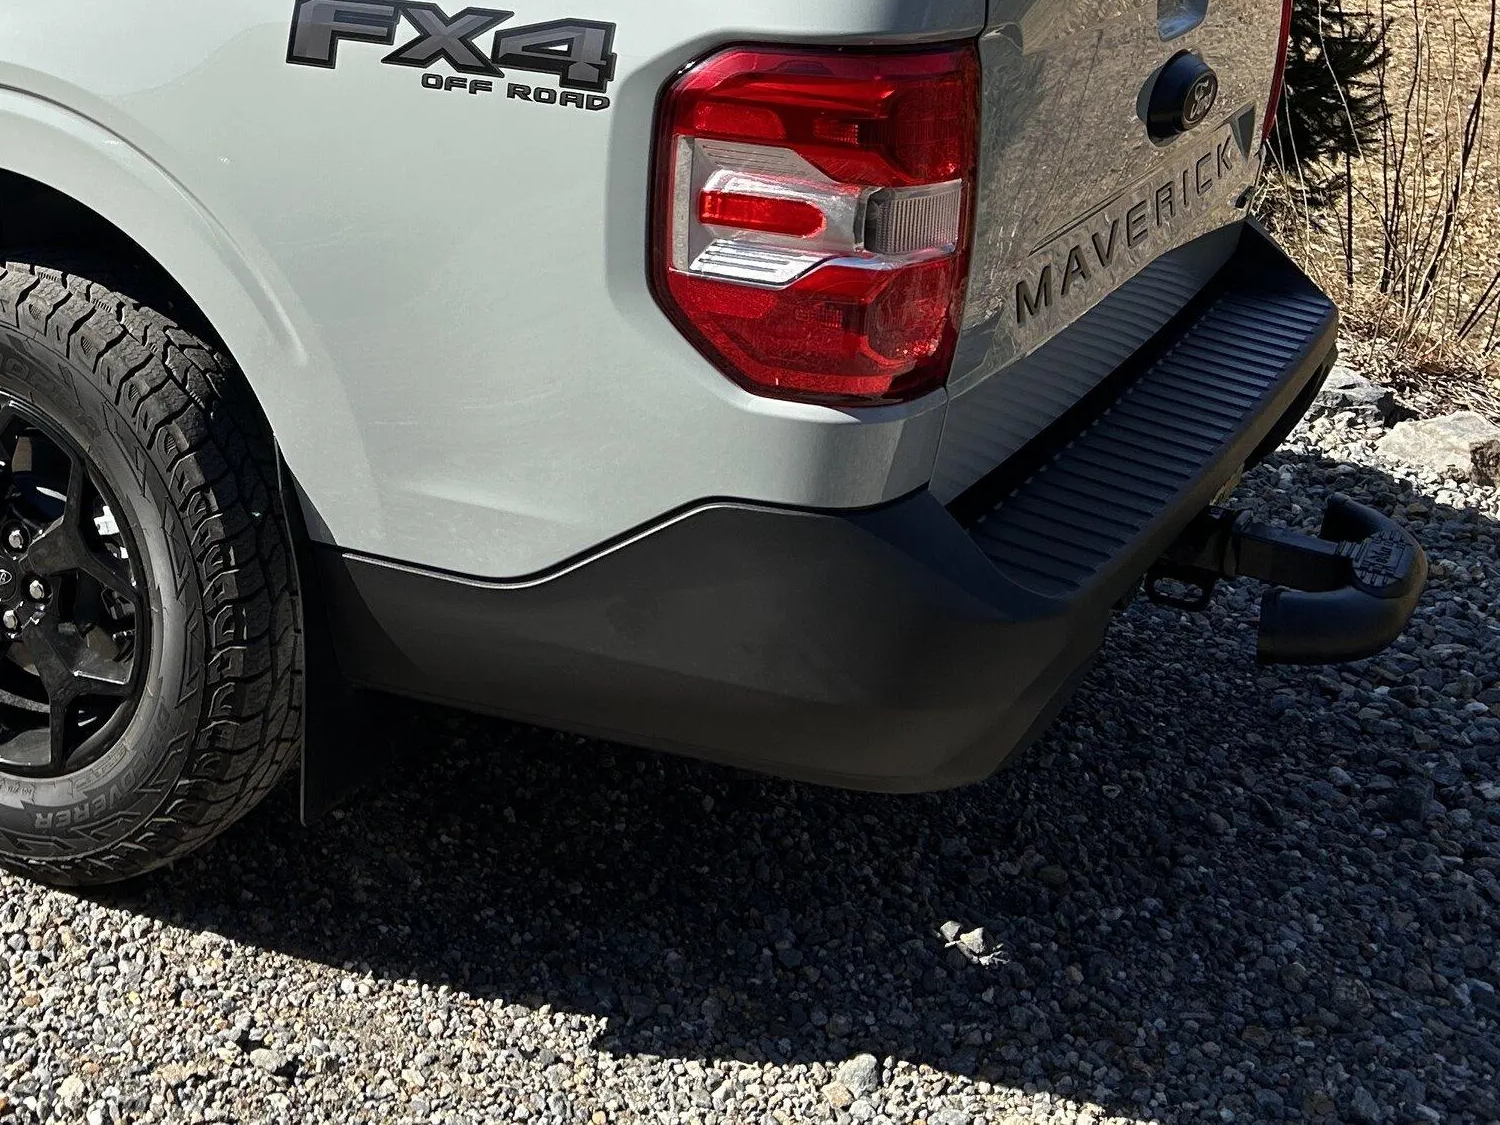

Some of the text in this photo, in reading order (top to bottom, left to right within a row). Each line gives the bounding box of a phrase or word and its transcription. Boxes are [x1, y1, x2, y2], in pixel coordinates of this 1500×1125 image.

[420, 73, 611, 111] OFF ROAD
[1015, 134, 1234, 324] MAVERICK
[34, 696, 173, 829] DCOVERER
